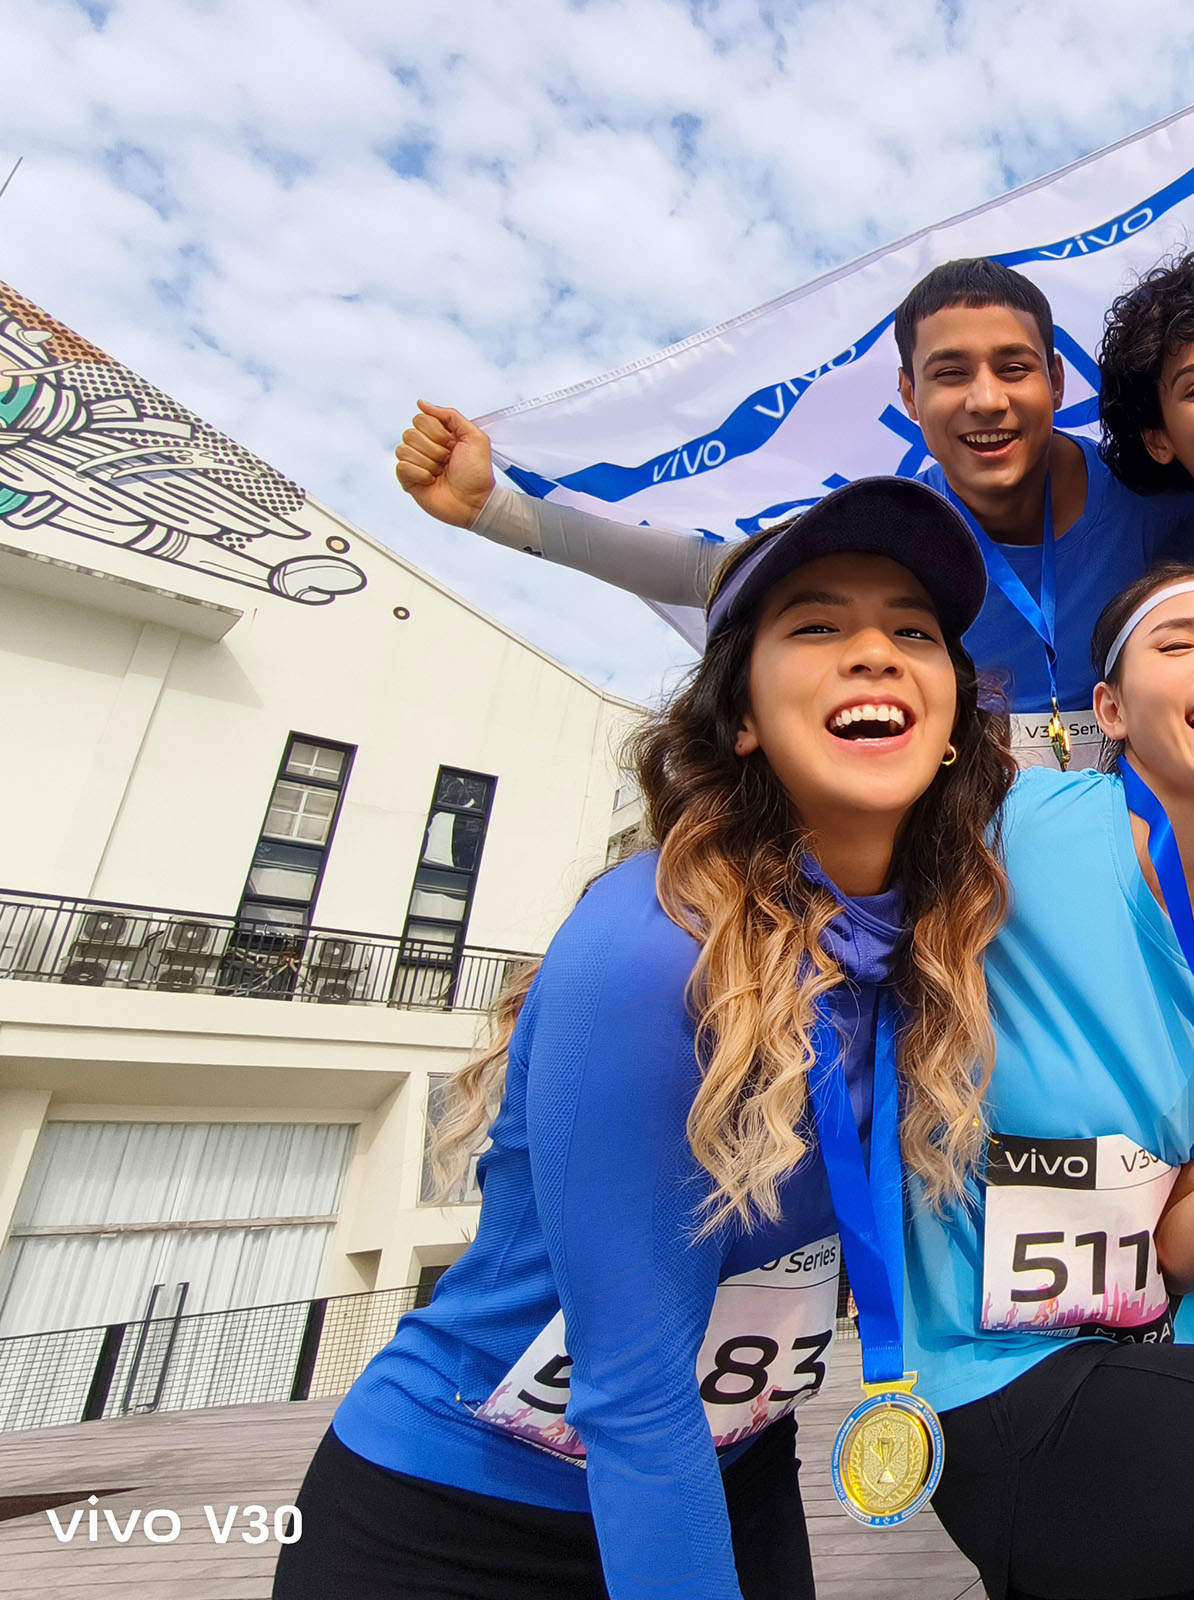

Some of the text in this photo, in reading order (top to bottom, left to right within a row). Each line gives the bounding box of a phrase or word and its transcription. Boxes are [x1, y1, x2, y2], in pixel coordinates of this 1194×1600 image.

[653, 440, 726, 482] vivo
[1040, 207, 1154, 260] vivo
[1025, 721, 1104, 738] V3 Seri
[1005, 1148, 1089, 1177] vivo
[785, 1245, 836, 1274] Series
[1010, 1230, 1160, 1303] 511
